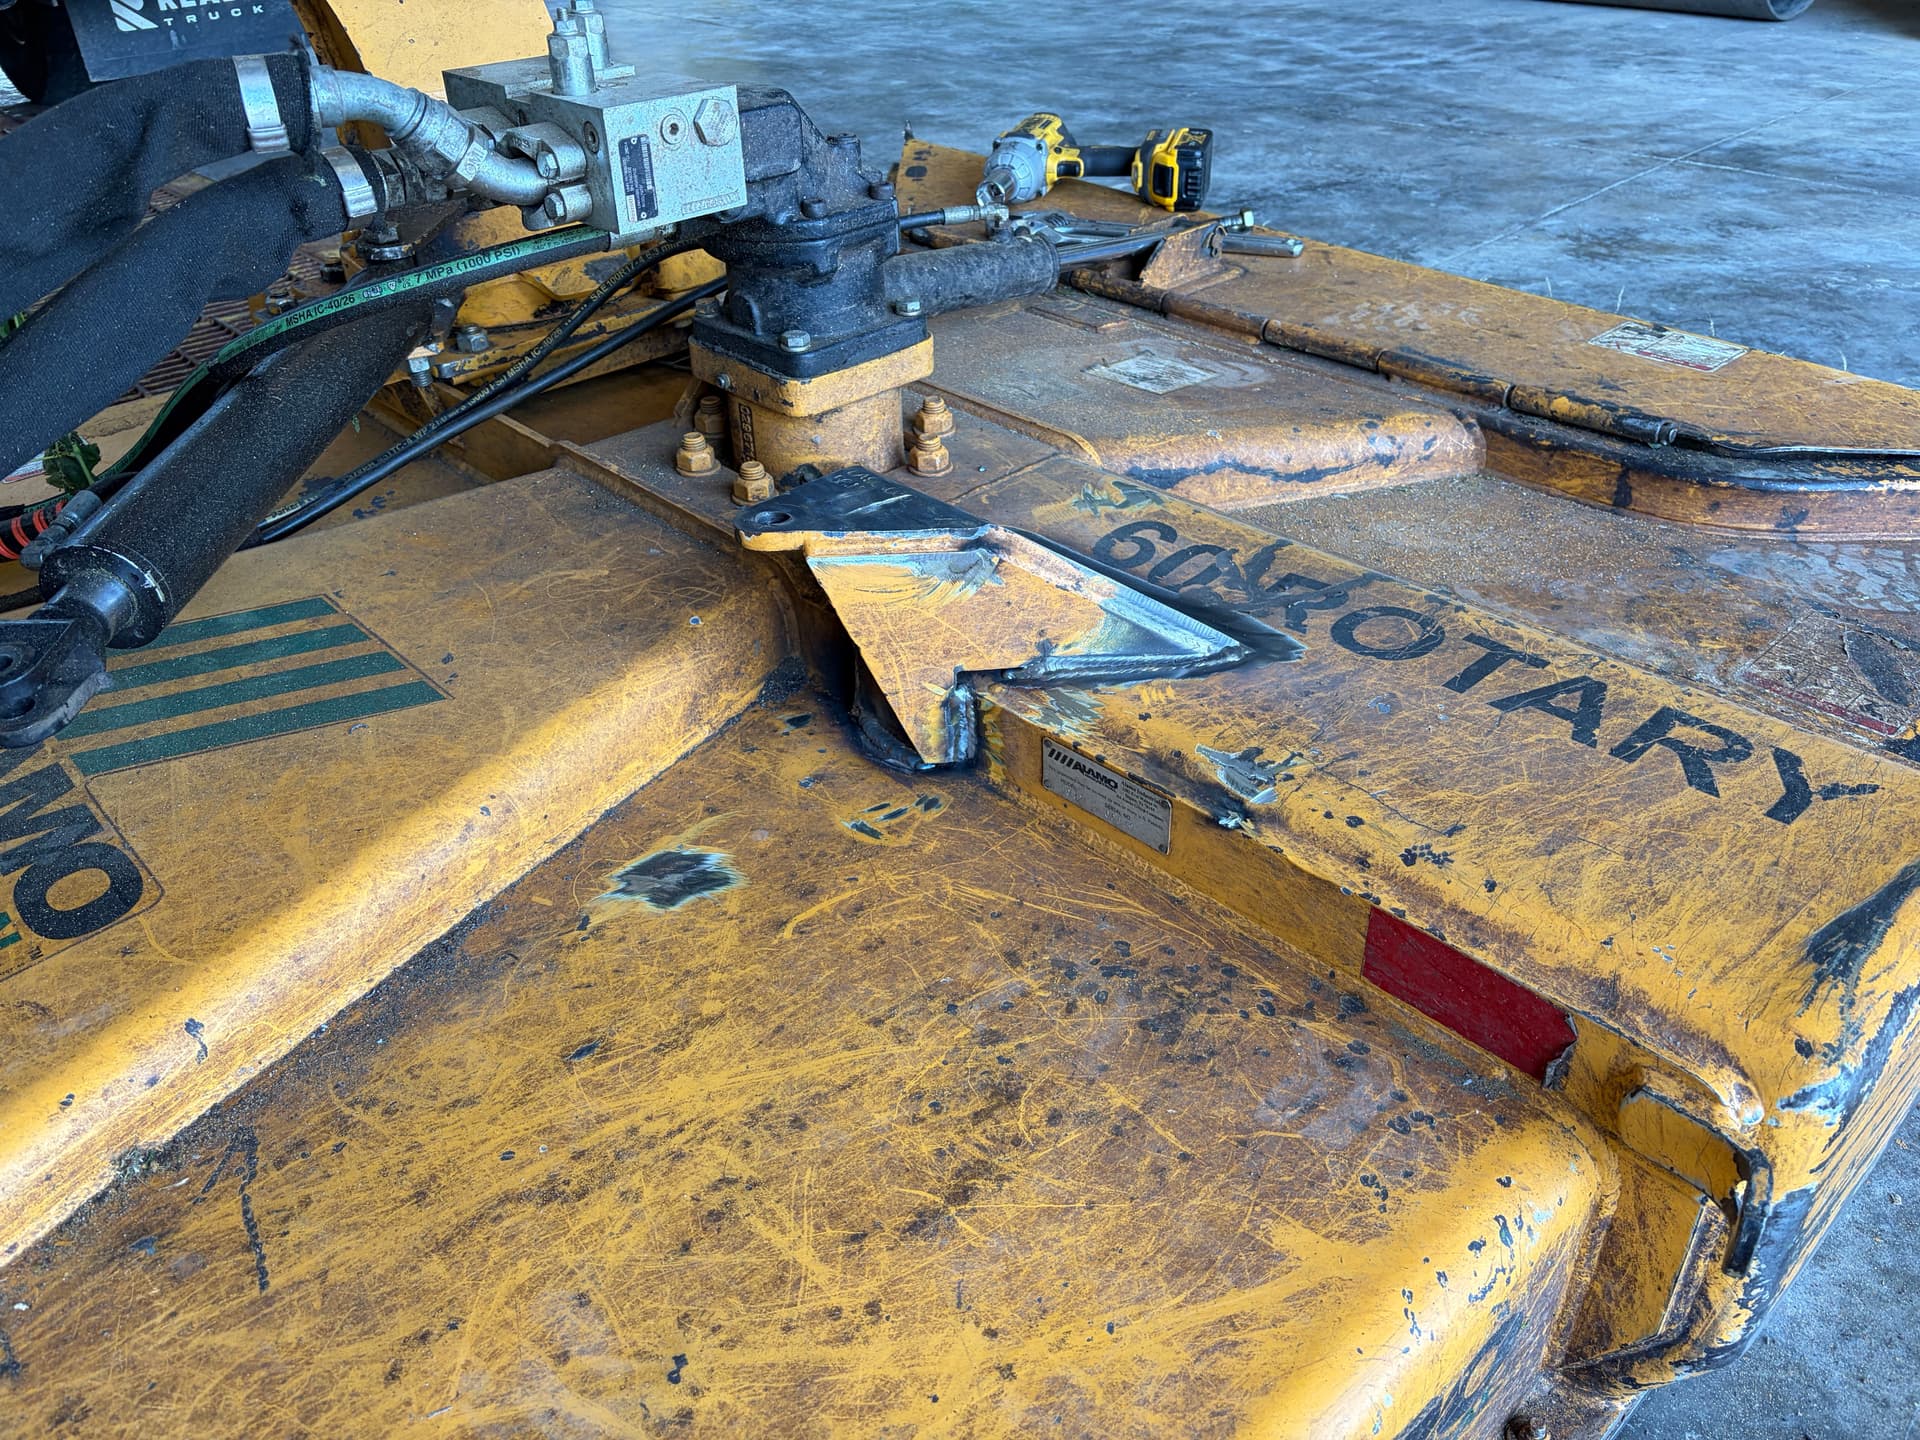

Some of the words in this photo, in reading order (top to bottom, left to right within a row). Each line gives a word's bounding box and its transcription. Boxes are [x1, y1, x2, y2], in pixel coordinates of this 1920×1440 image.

[163, 5, 264, 26] TRUCK
[414, 274, 423, 285] 7
[426, 266, 453, 282] MPa
[456, 254, 492, 272] (1000
[495, 246, 521, 261] PSI)
[285, 306, 313, 327] MSHA
[313, 294, 356, 316] IC-40/26
[507, 356, 532, 378] MSHA
[590, 284, 608, 302] SAE
[1266, 573, 1881, 825] ROTARY
[1072, 763, 1118, 790] ALAMO
